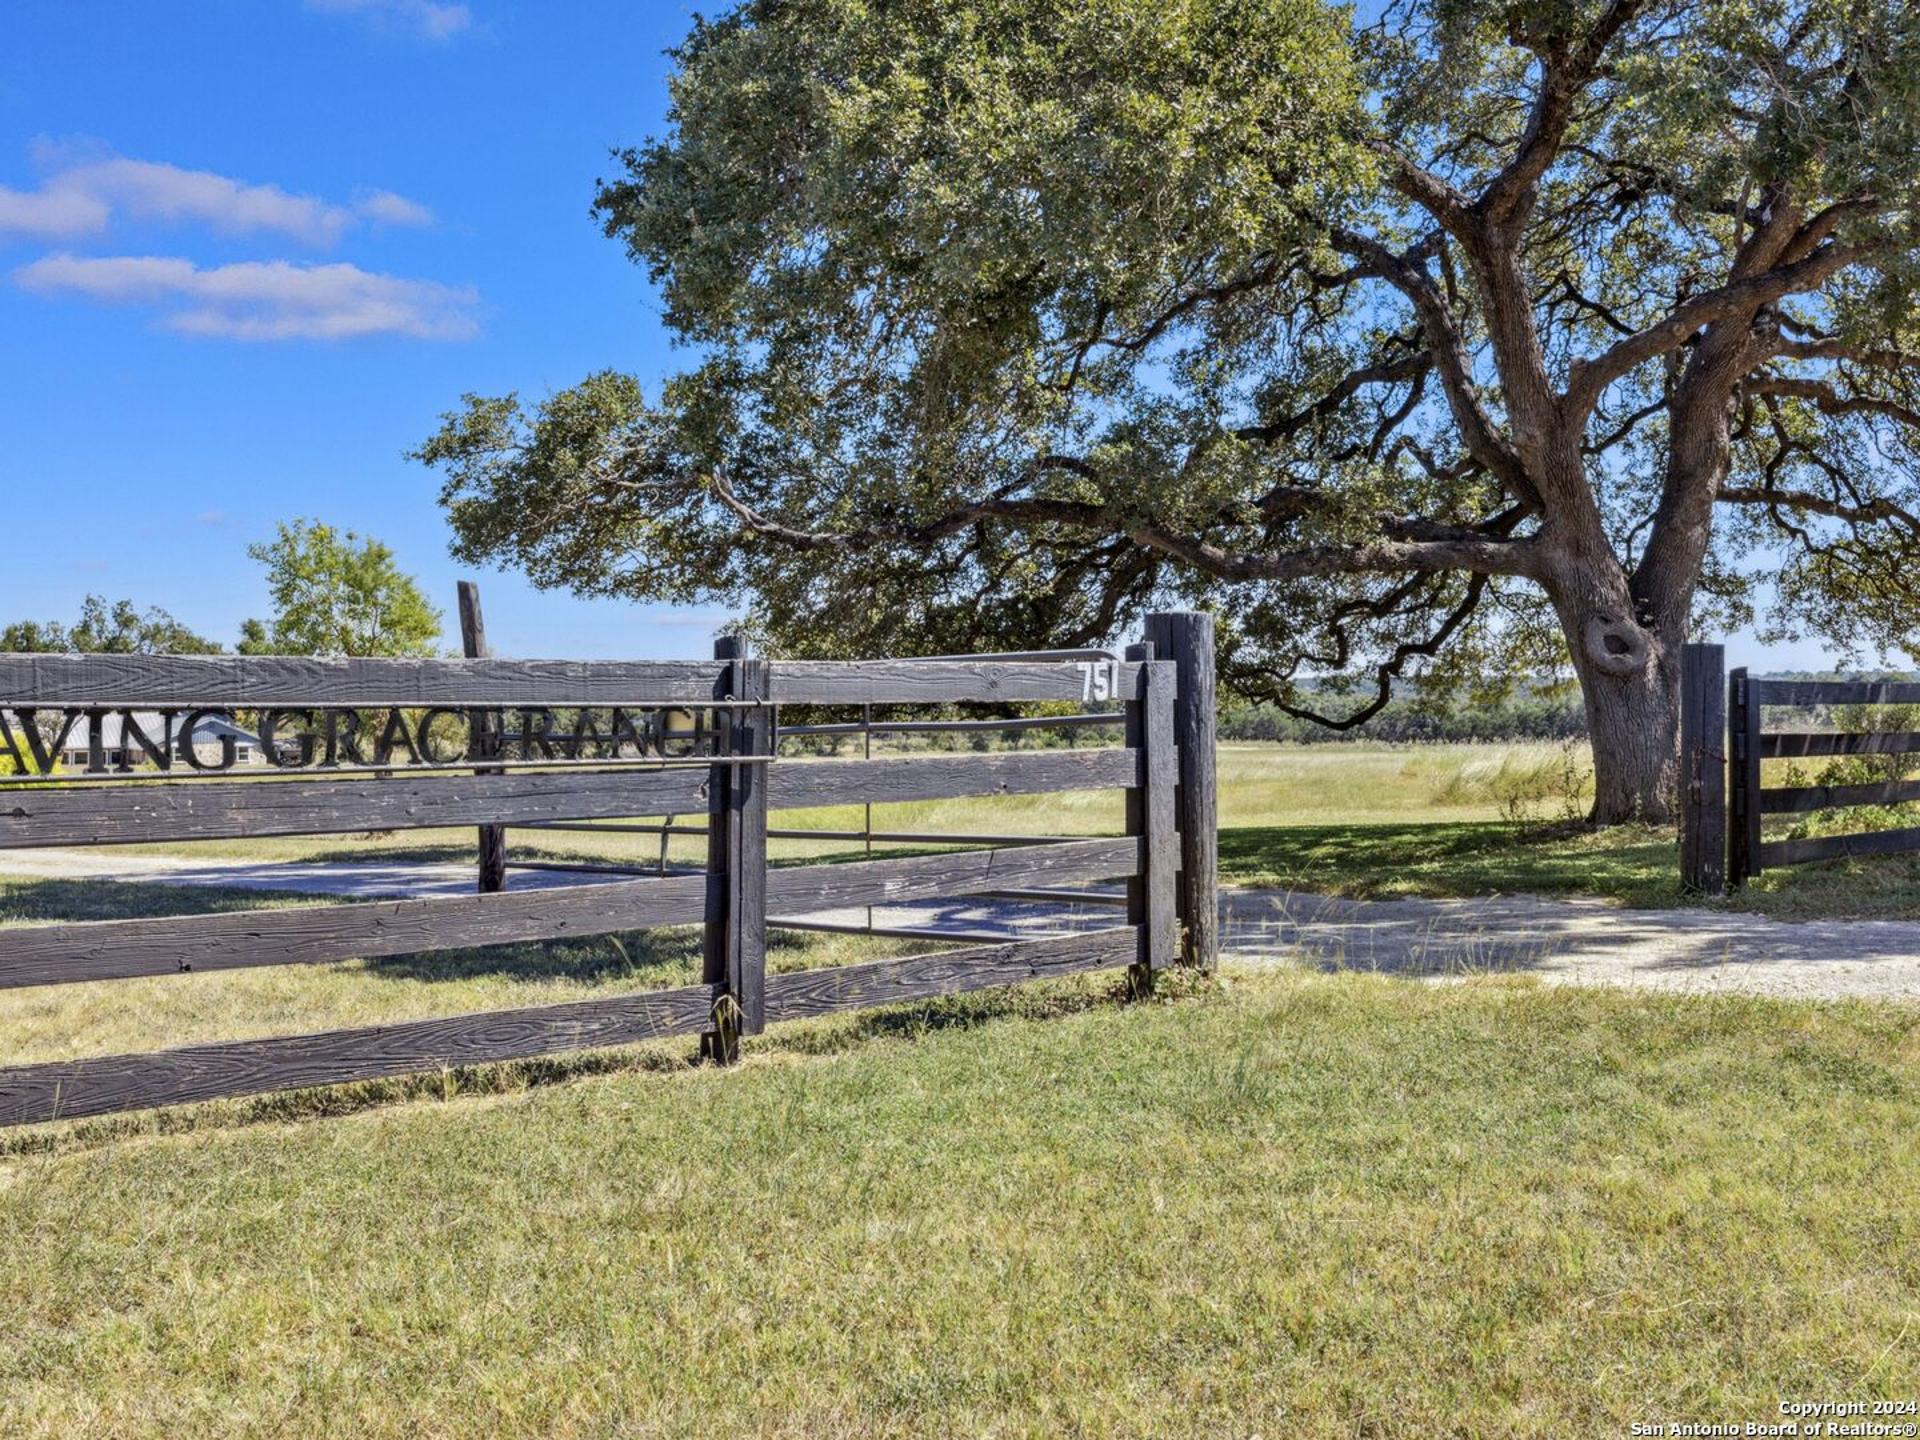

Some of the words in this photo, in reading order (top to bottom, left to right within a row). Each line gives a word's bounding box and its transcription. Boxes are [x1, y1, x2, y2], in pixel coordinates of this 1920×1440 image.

[1076, 660, 1119, 702] 751
[256, 706, 504, 768] GRACE
[516, 705, 732, 760] RANCH
